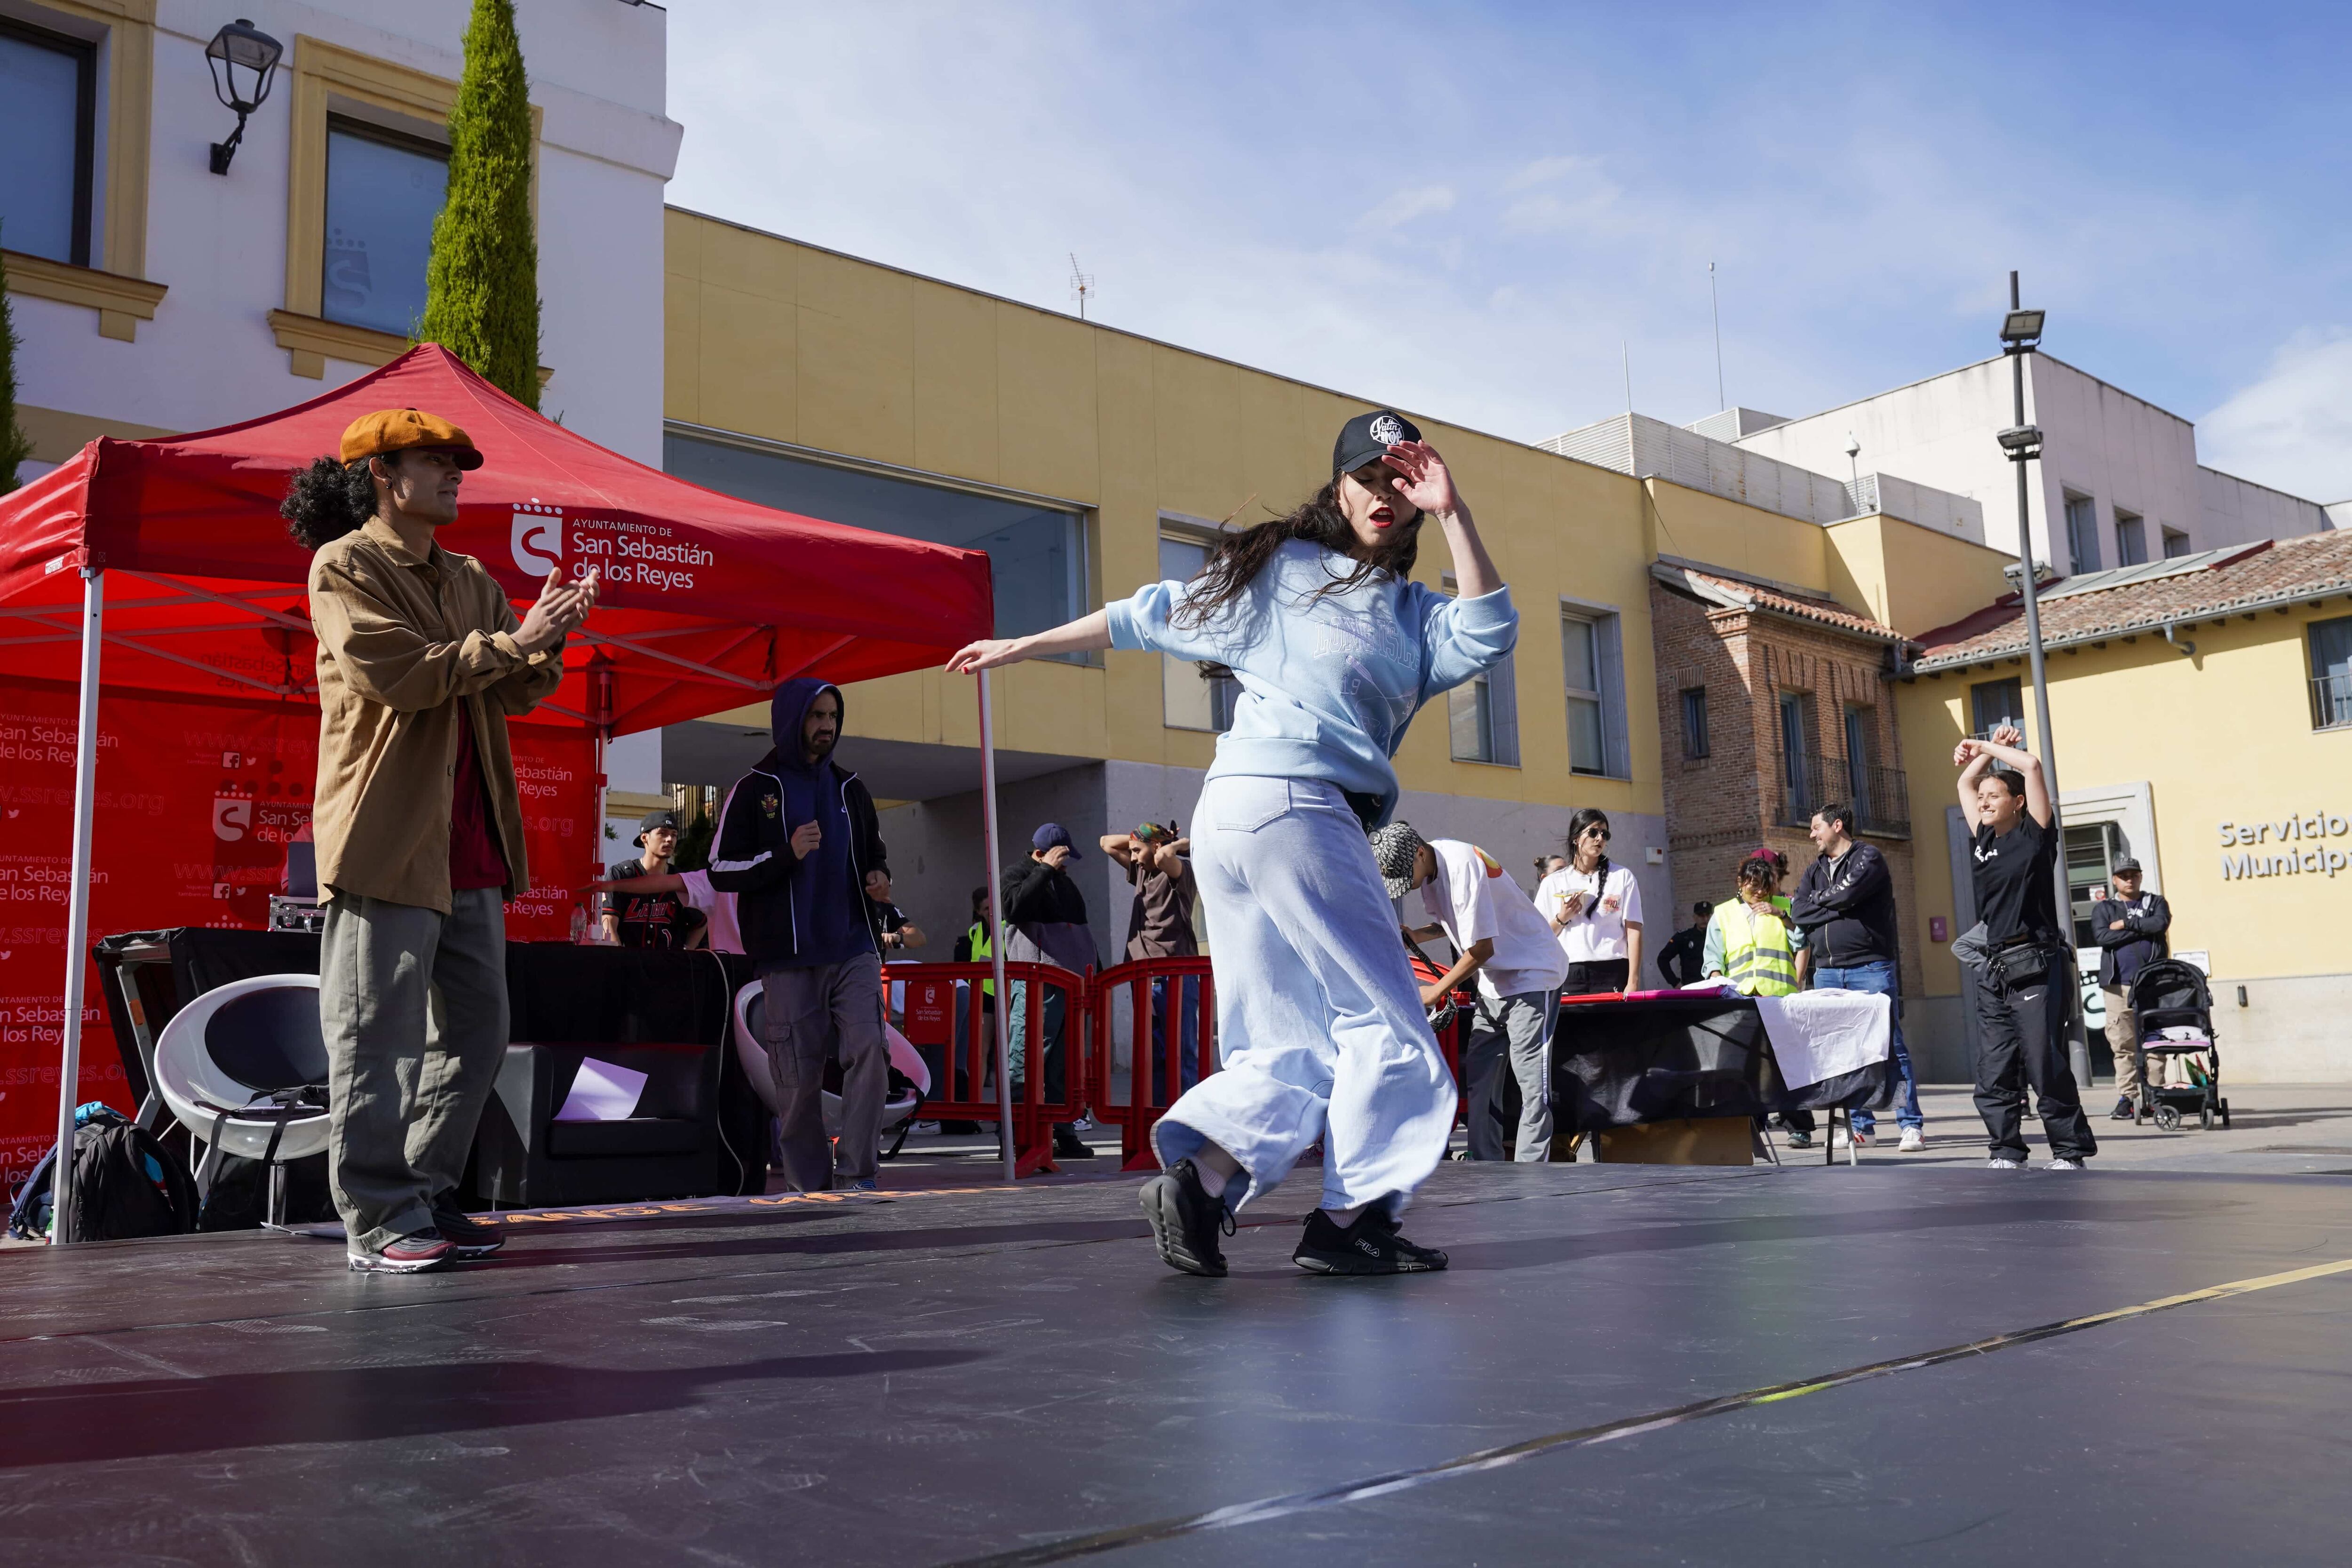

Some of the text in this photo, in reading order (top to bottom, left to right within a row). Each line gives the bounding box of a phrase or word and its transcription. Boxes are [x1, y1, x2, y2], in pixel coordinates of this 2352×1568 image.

[1371, 417, 1398, 439] Latin
[573, 519, 672, 537] AYUNTAMIENTO DE
[573, 533, 713, 566] San Sebastián
[605, 558, 632, 582] los
[637, 563, 693, 591] Reyes
[1314, 617, 1374, 659] LONG
[1341, 675, 1361, 695] 19
[0, 714, 68, 725] YUNTAMIENTO
[0, 724, 118, 748] an Sebaán
[19, 743, 43, 761] los
[48, 746, 99, 768] Reys
[514, 764, 572, 781] ebastián
[518, 780, 557, 799] Reyes
[260, 801, 313, 810] AYUNTAMIEN
[259, 810, 287, 825] San
[257, 827, 295, 843] de lo
[2217, 810, 2352, 848] Servicio
[0, 855, 58, 864] UNTAMIENTO
[0, 866, 108, 883] an Sebasán
[11, 884, 35, 900] los
[39, 885, 71, 906] Rey
[516, 885, 567, 899] astián
[512, 900, 554, 918] Reyes
[16, 1005, 100, 1023] Sebasán
[4, 1025, 27, 1043] los
[0, 1135, 50, 1145] NTAMIENTO
[5, 1166, 29, 1184] los
[1355, 1238, 1380, 1257] FILA
